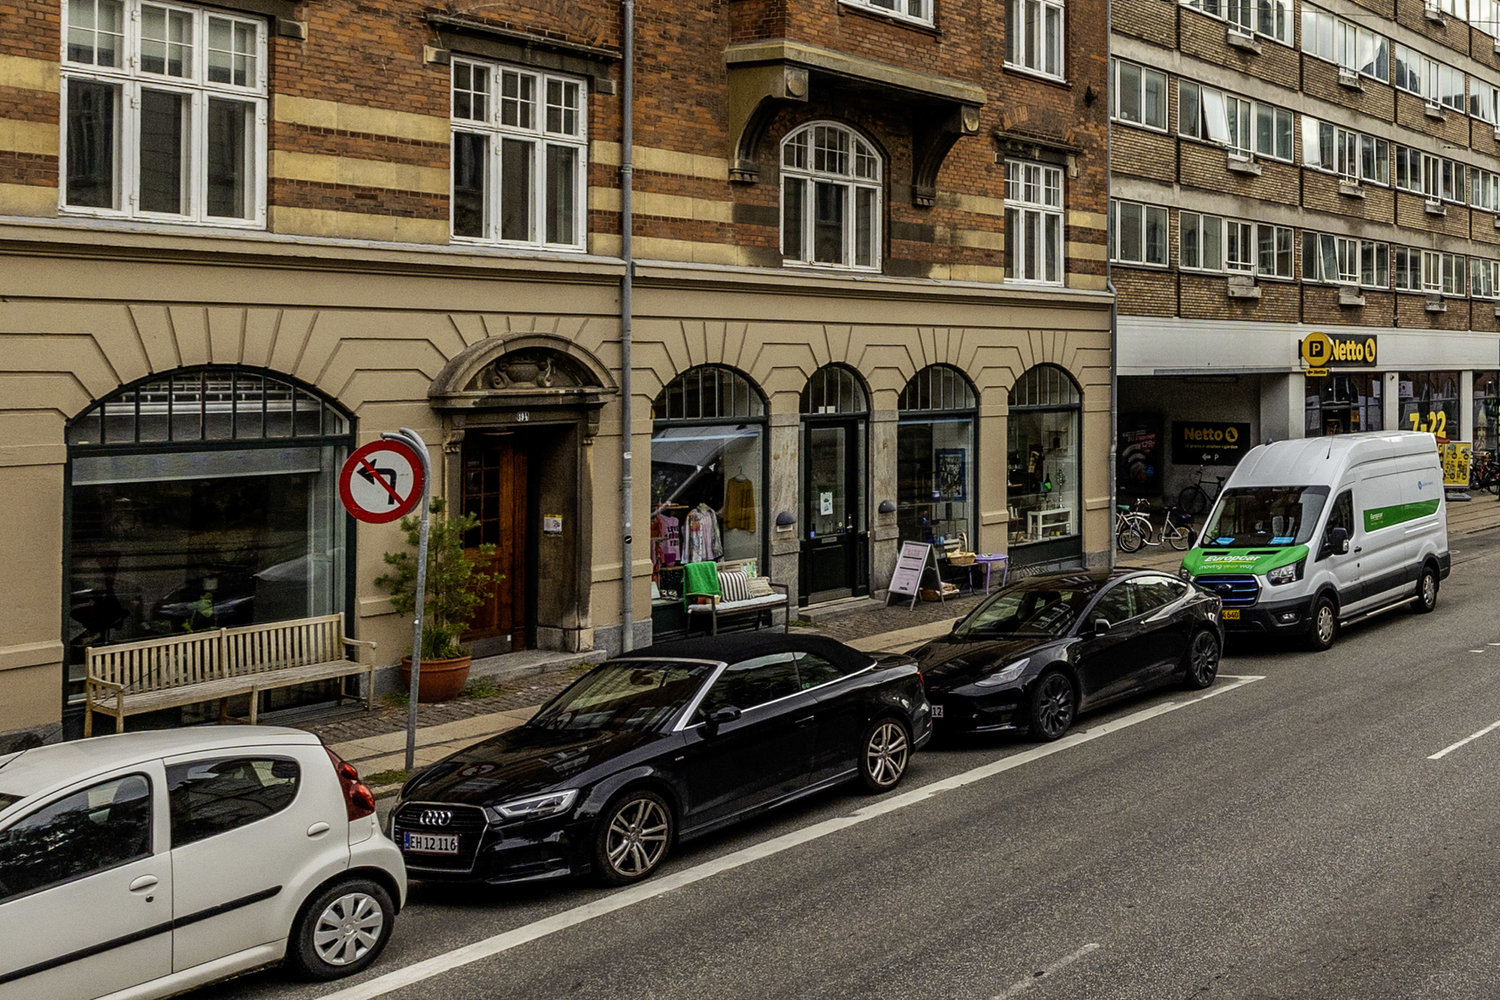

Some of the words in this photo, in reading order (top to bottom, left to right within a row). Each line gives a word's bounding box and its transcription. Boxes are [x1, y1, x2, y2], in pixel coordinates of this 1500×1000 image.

[1331, 339, 1364, 361] Netto
[1184, 427, 1224, 441] Netto
[1204, 555, 1261, 563] Europcar
[410, 836, 422, 849] EH
[424, 837, 436, 850] 12
[439, 838, 457, 851] 116
